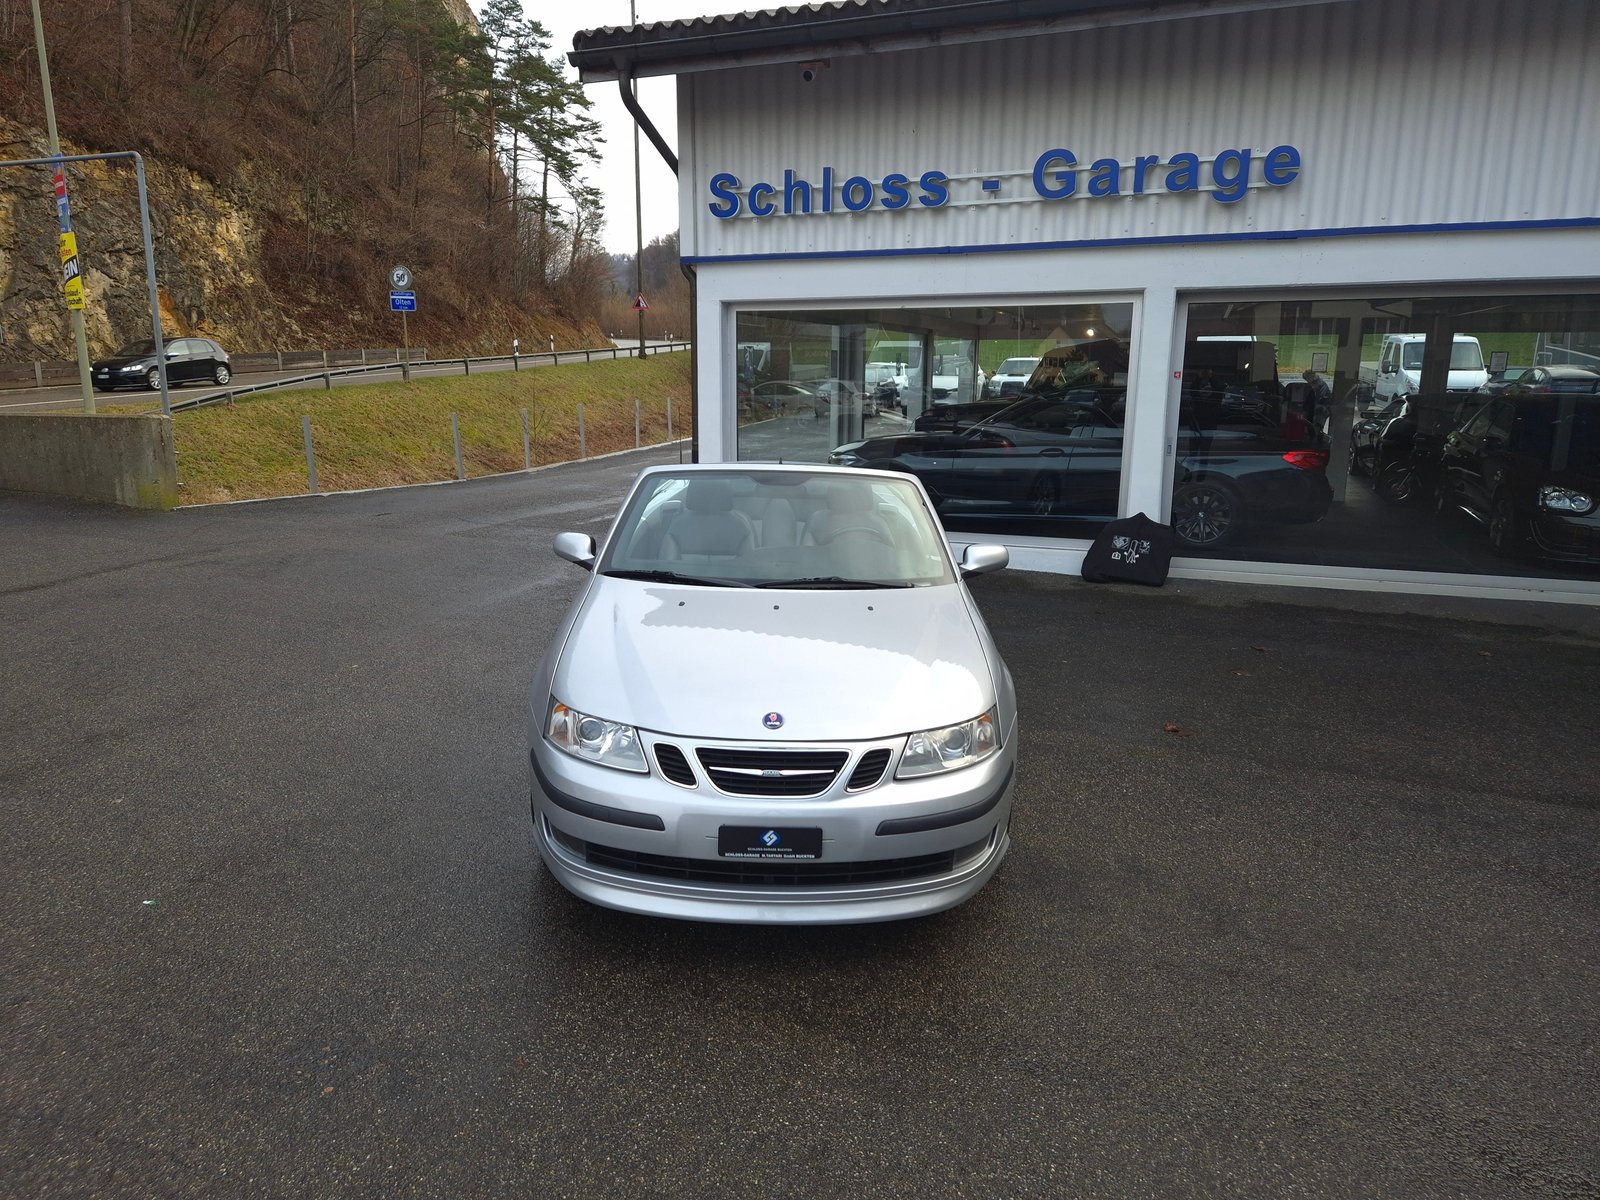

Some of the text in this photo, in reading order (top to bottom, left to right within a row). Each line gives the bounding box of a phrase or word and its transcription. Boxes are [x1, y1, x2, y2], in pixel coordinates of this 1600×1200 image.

[709, 167, 948, 219] Schloss
[1032, 144, 1301, 204] Garage
[396, 273, 405, 282] 50
